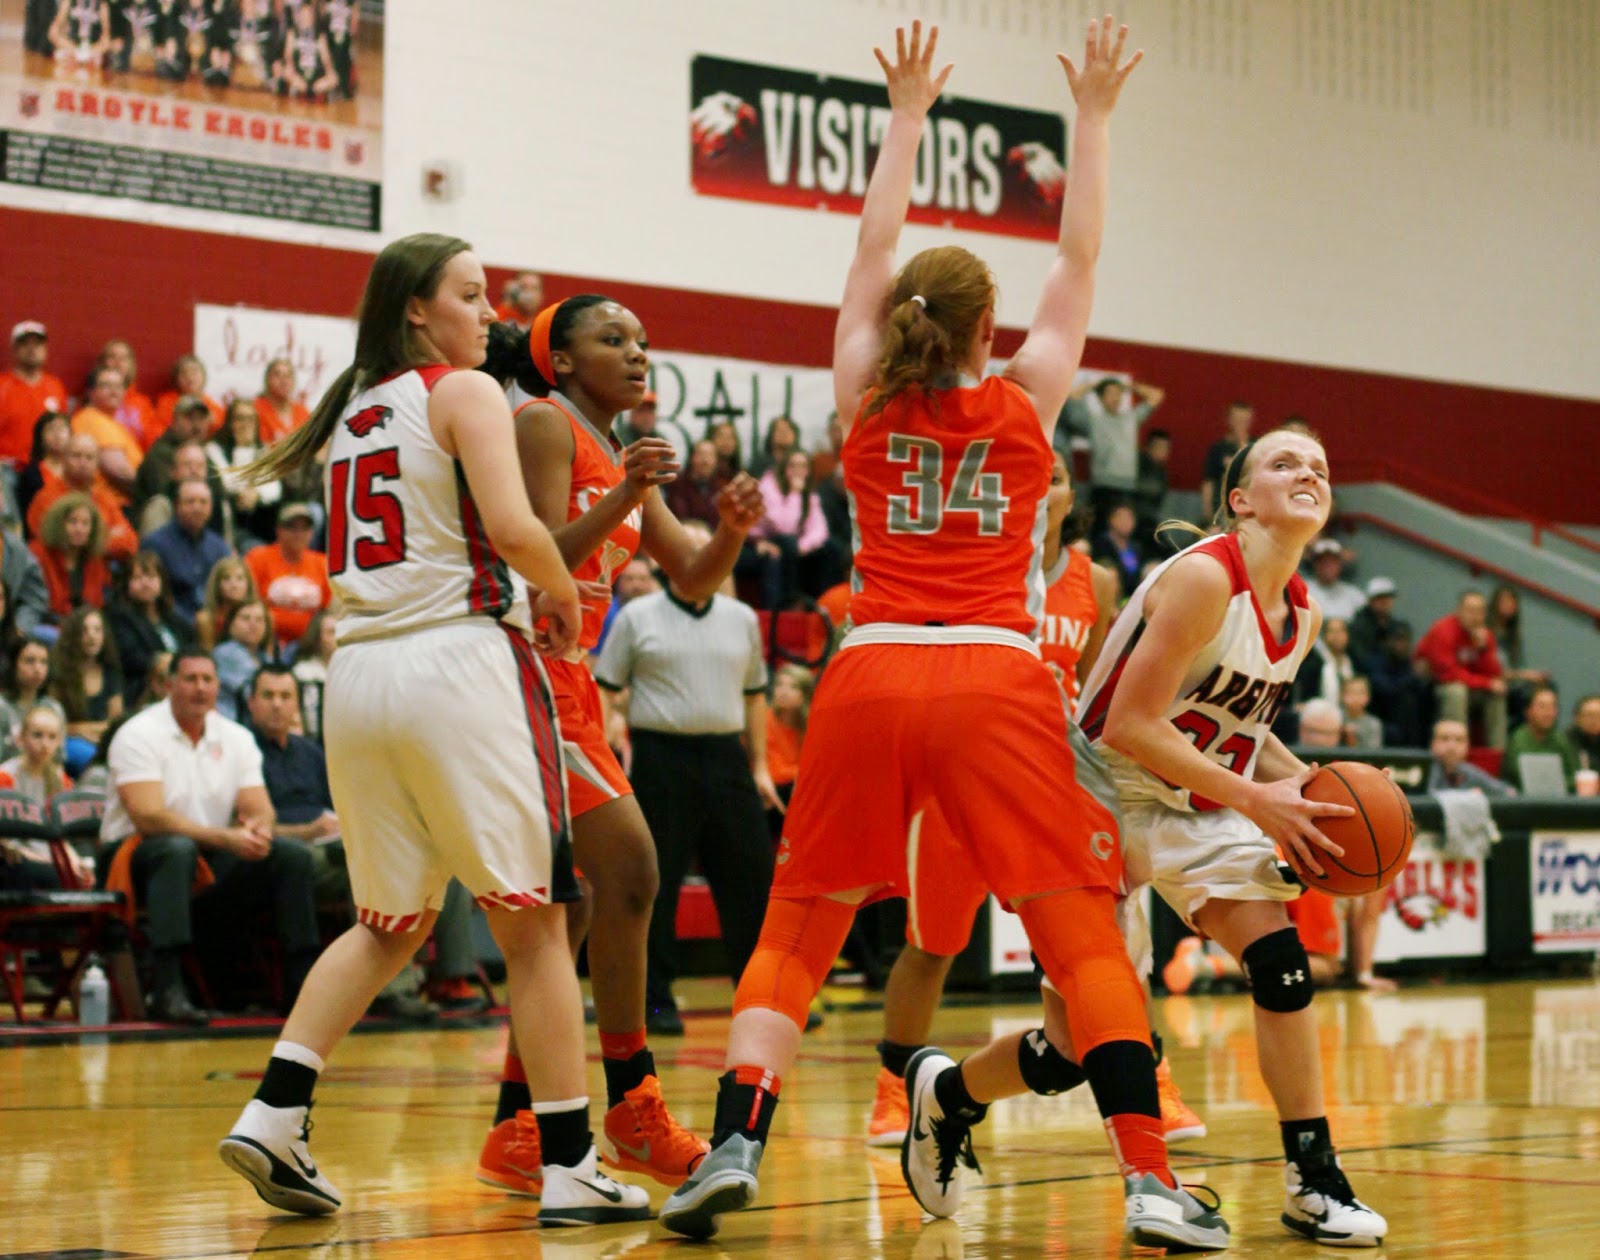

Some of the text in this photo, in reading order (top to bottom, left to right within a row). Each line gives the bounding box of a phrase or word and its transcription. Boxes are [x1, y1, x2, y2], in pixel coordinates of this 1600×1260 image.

[54, 88, 333, 151] ARGYLE EAGLES
[327, 445, 407, 577] 15
[887, 432, 1010, 536] 34
[1090, 831, 1114, 861] C
